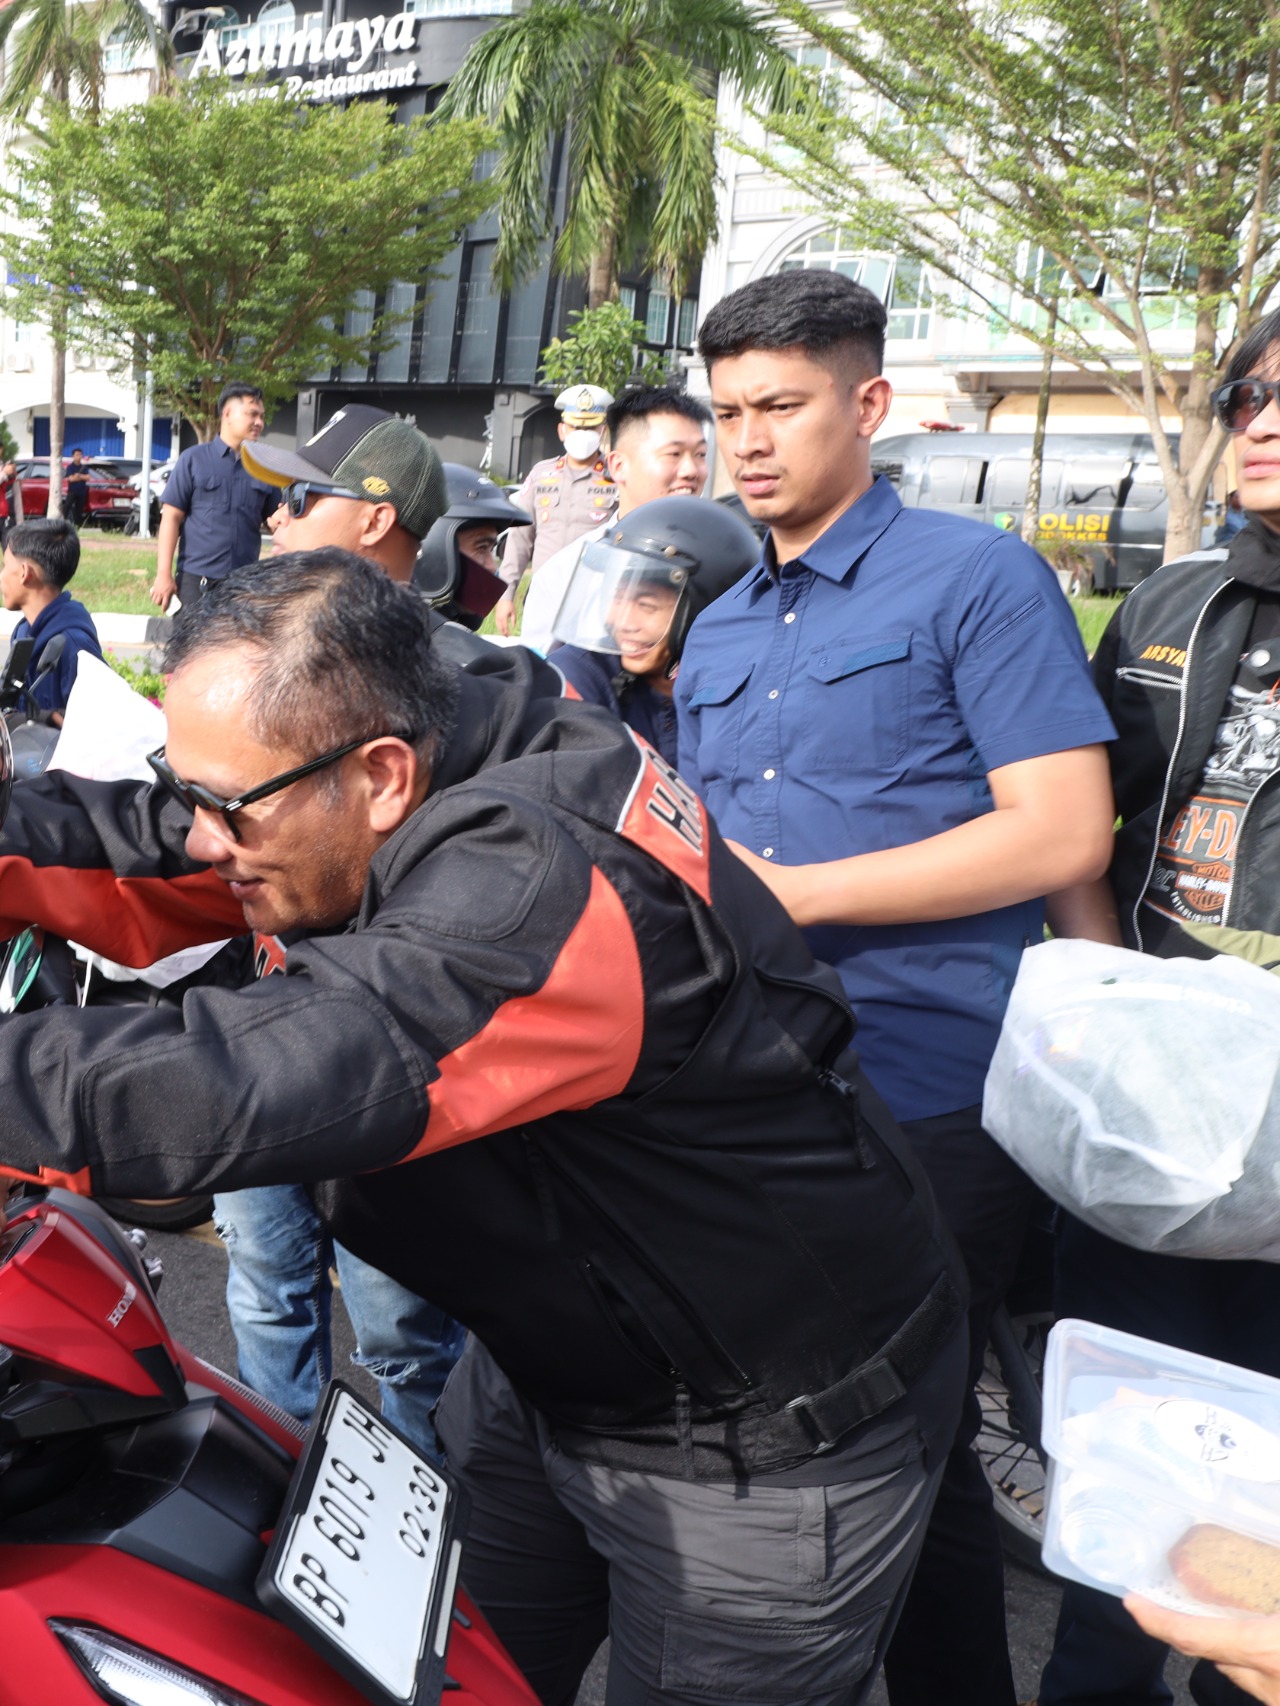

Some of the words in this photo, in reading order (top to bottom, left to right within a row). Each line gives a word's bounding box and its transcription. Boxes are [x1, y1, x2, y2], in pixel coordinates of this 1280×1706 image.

[189, 11, 416, 80] Azumaya
[284, 60, 417, 102] Restaurant
[536, 486, 560, 495] REZA
[587, 486, 617, 495] POLRI
[1038, 512, 1111, 532] OLISI
[1159, 804, 1238, 860] EY-D
[343, 1401, 392, 1463] JH
[314, 1457, 375, 1562] 6019
[293, 1553, 349, 1628] BP
